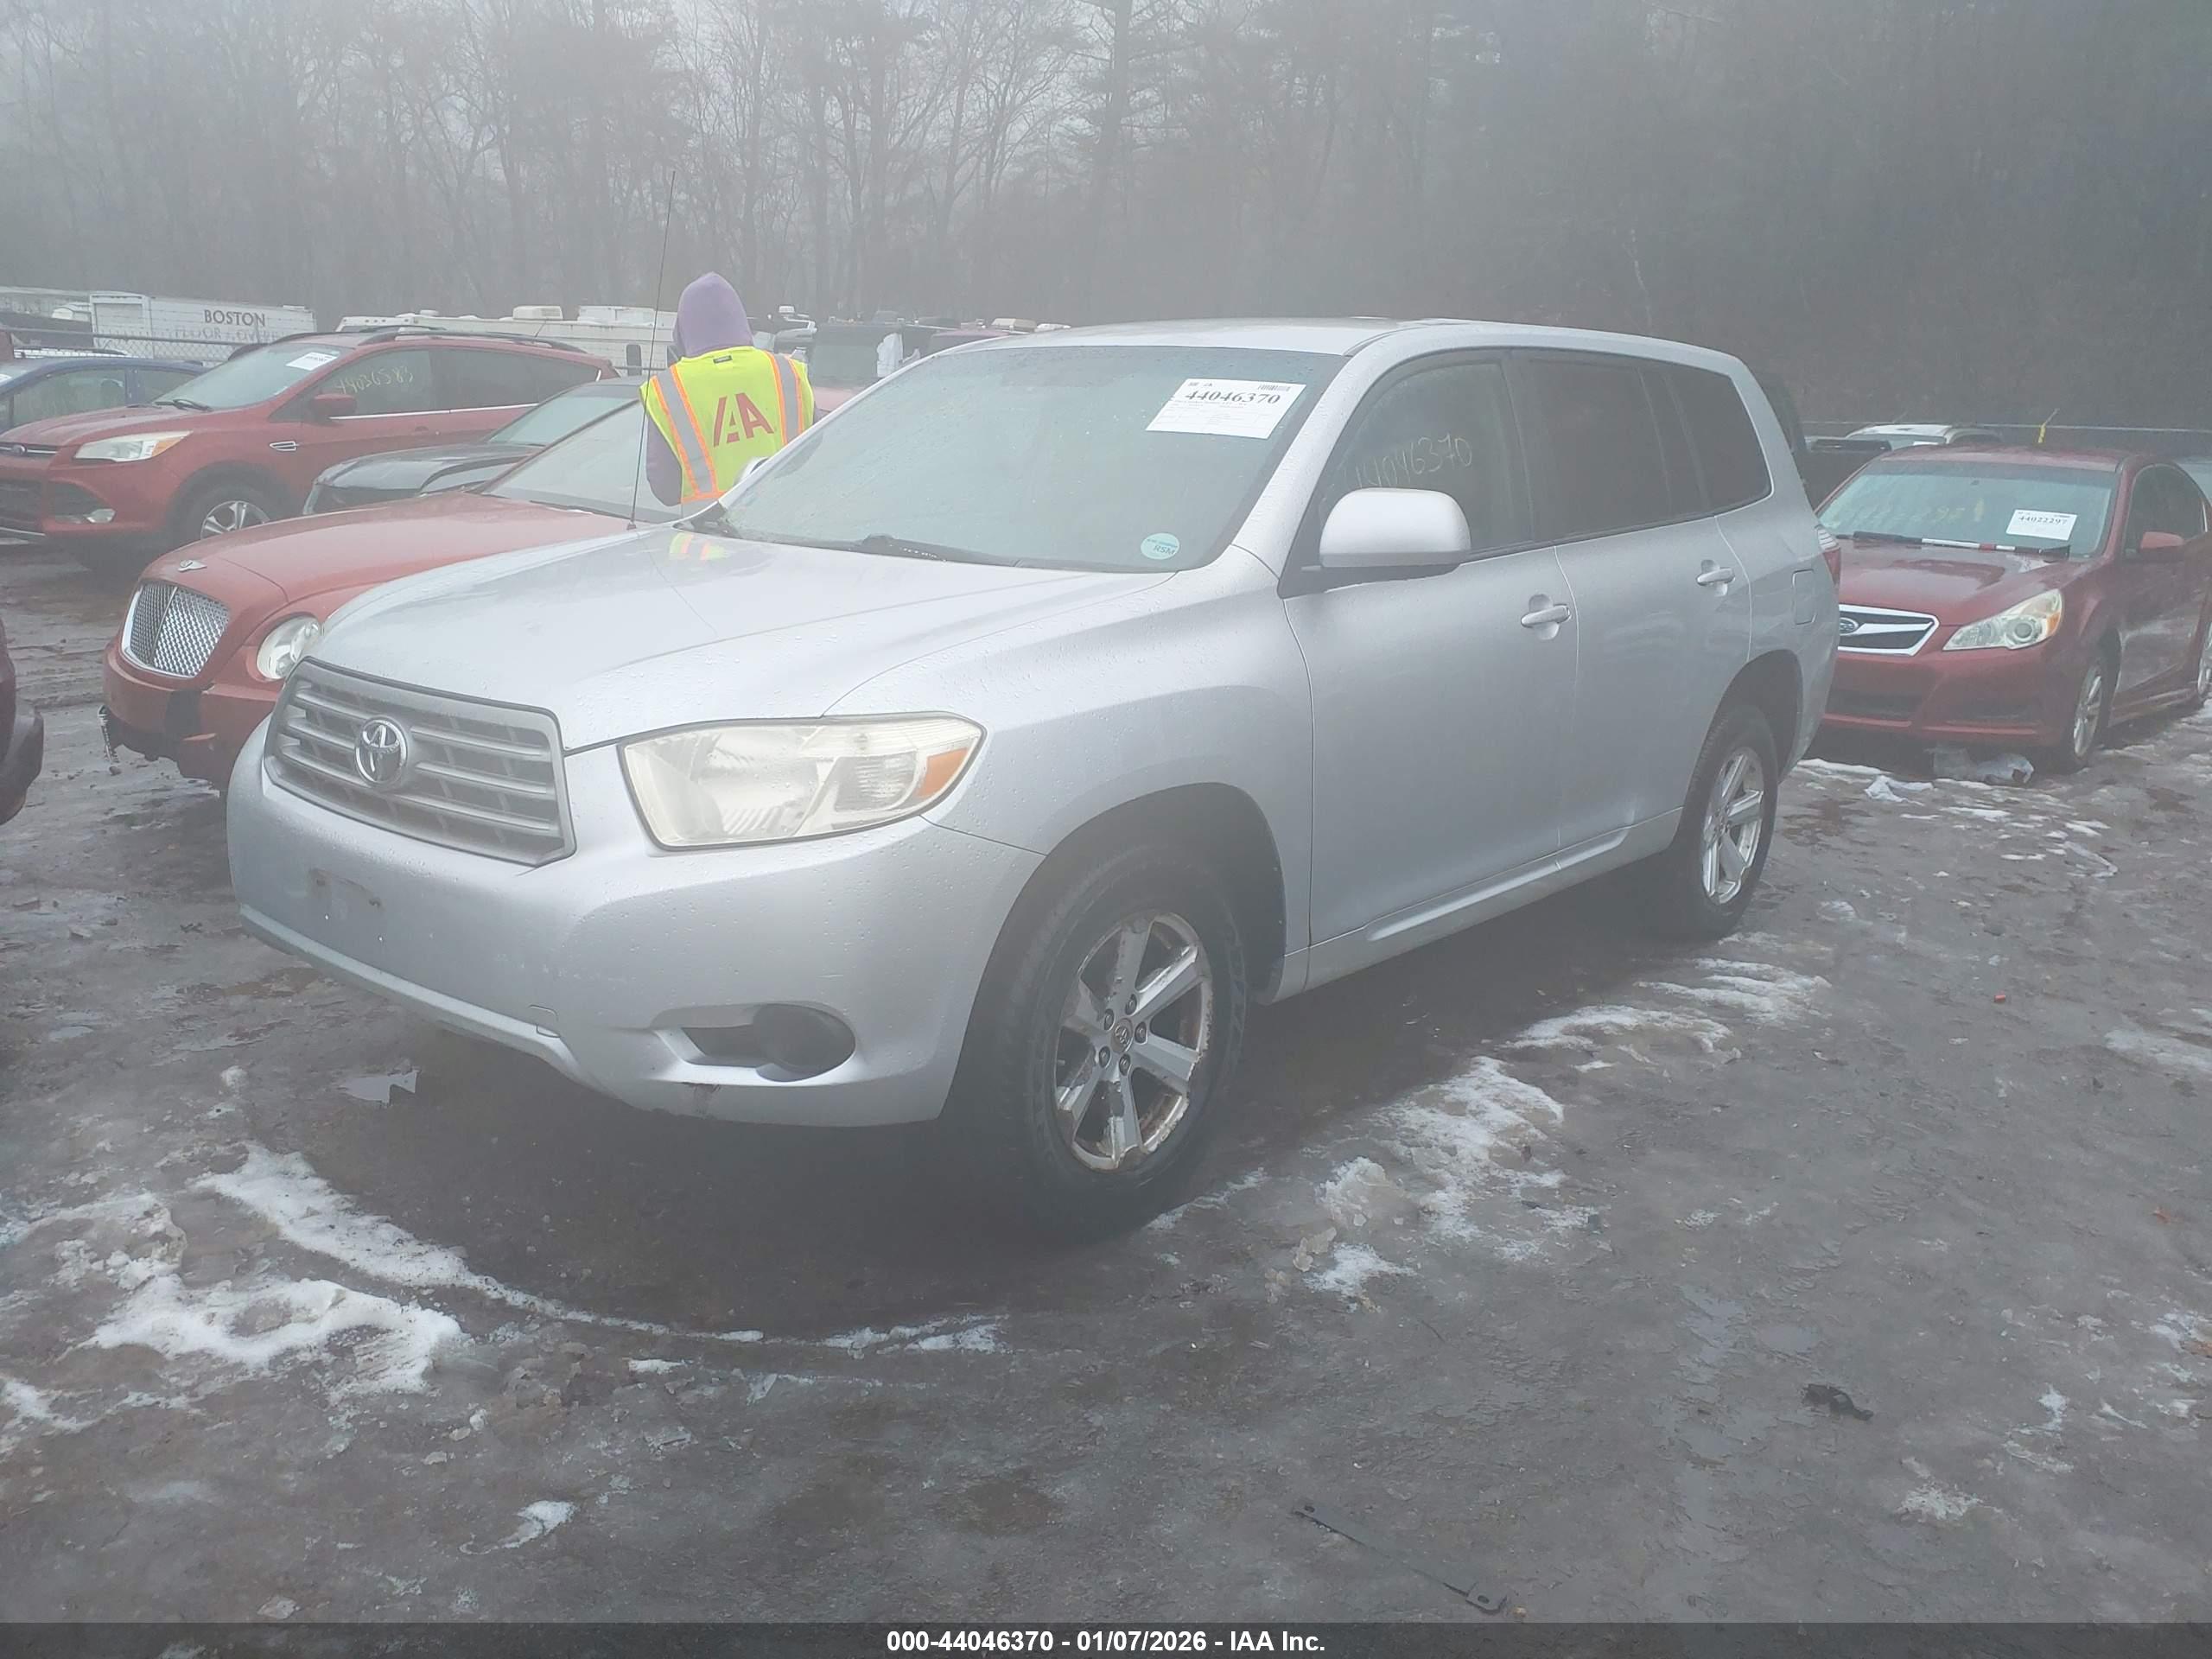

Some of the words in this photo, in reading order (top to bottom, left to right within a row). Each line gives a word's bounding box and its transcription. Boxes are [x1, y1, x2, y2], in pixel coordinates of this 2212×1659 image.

[203, 309, 266, 327] BOSTON
[1185, 391, 1281, 404] 44046370
[2018, 515, 2069, 525] 44022297
